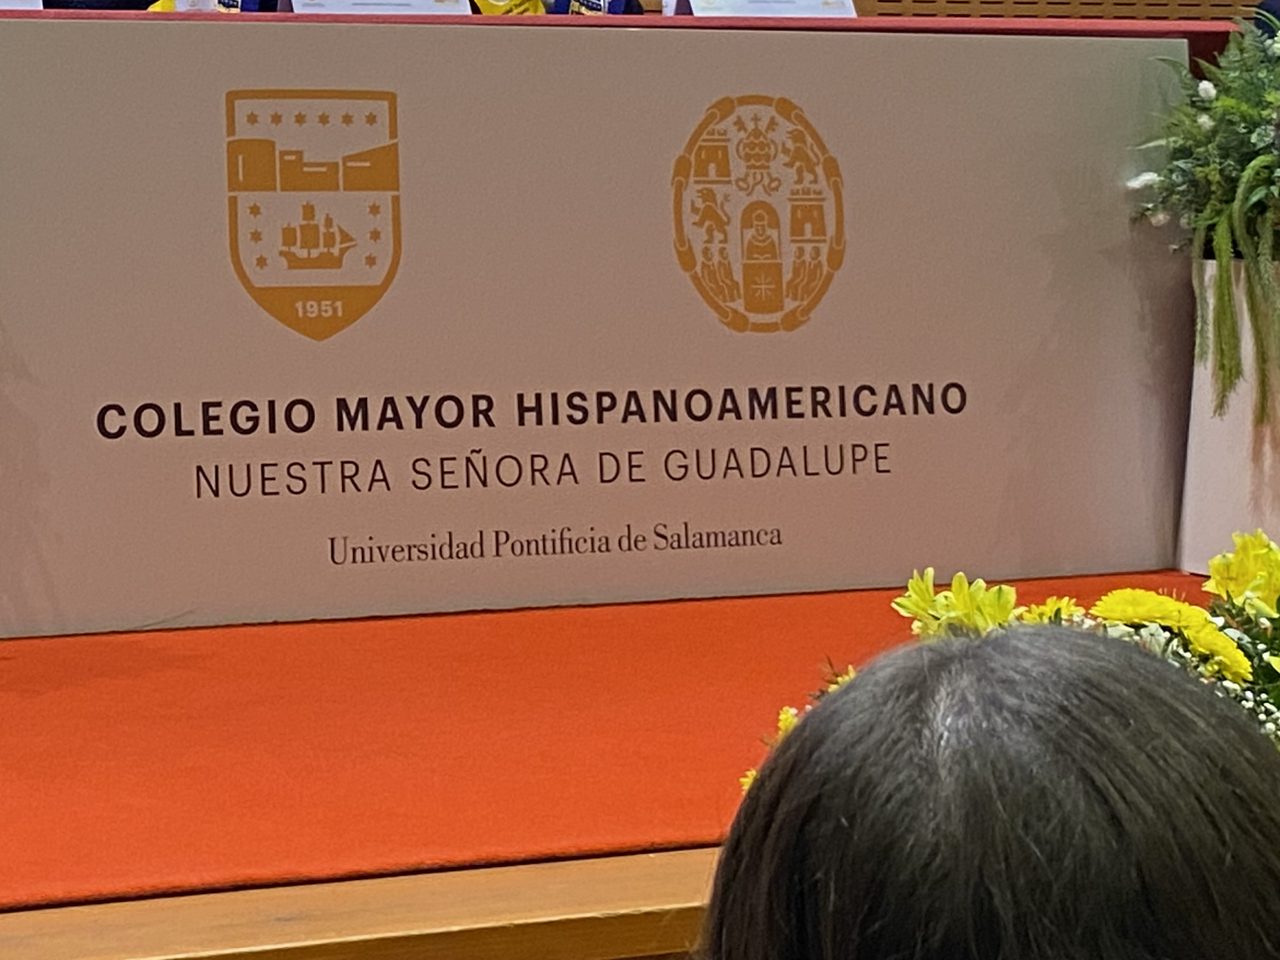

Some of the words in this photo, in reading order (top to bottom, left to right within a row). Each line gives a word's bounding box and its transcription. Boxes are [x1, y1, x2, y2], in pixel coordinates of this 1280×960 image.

[295, 300, 343, 318] 1951
[97, 399, 316, 440] COLEGIO
[336, 394, 495, 433] MAYOR
[517, 381, 968, 427] HISPANOAMERICANO
[196, 459, 391, 499] NUESTRA
[412, 448, 579, 491] SEÑORA
[599, 451, 646, 483] DE
[664, 442, 892, 481] GUADALUPE
[328, 529, 486, 565] Universidad
[493, 527, 612, 558] Pontificia
[617, 524, 647, 552] de
[653, 522, 783, 551] Salamanca
